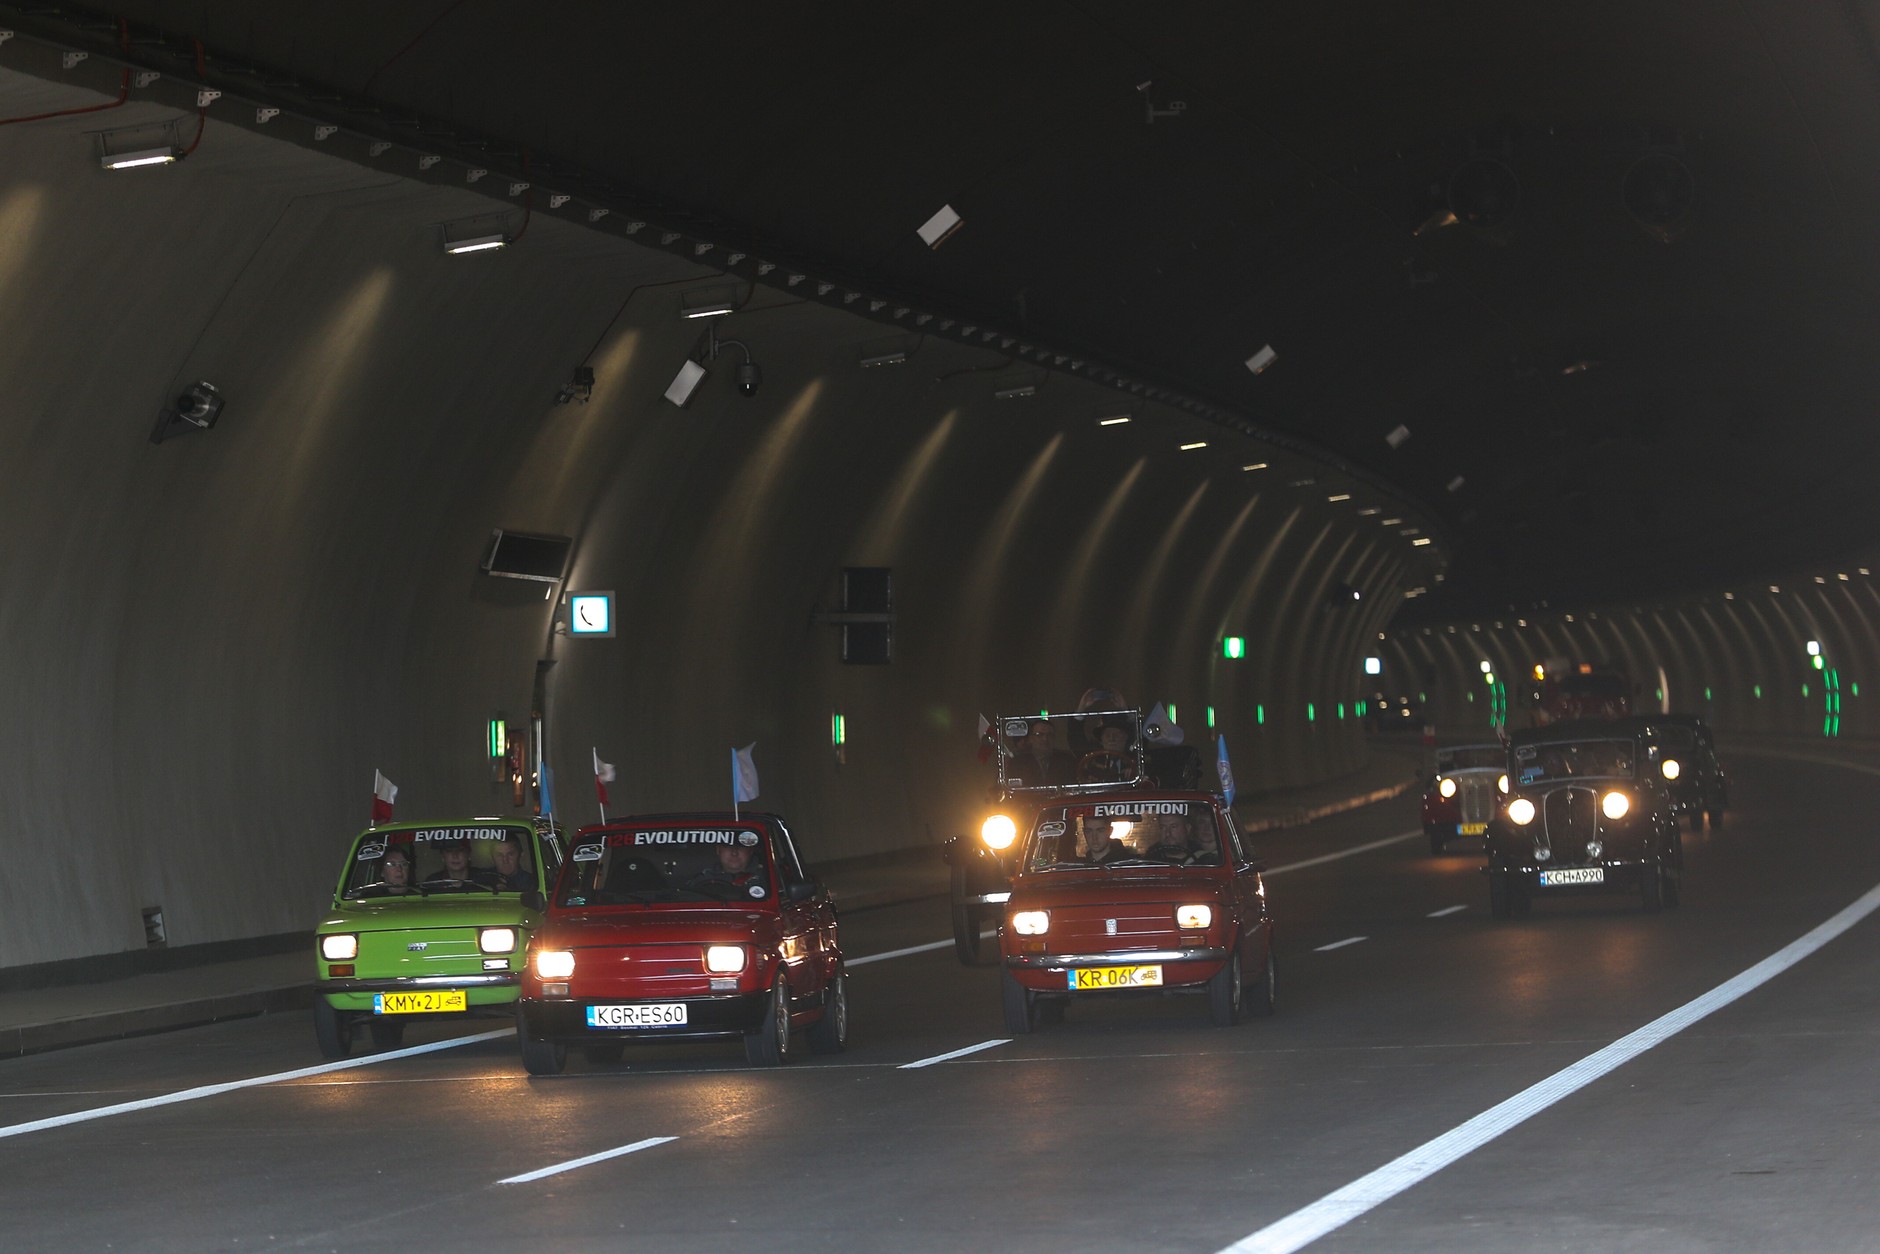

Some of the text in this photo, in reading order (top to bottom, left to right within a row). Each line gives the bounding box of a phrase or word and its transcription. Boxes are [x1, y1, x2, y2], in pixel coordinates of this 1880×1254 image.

[1575, 869, 1603, 882] A990
[1078, 970, 1102, 987] KR
[384, 994, 441, 1012] KMY 2J
[598, 1006, 683, 1024] KGR ES60
